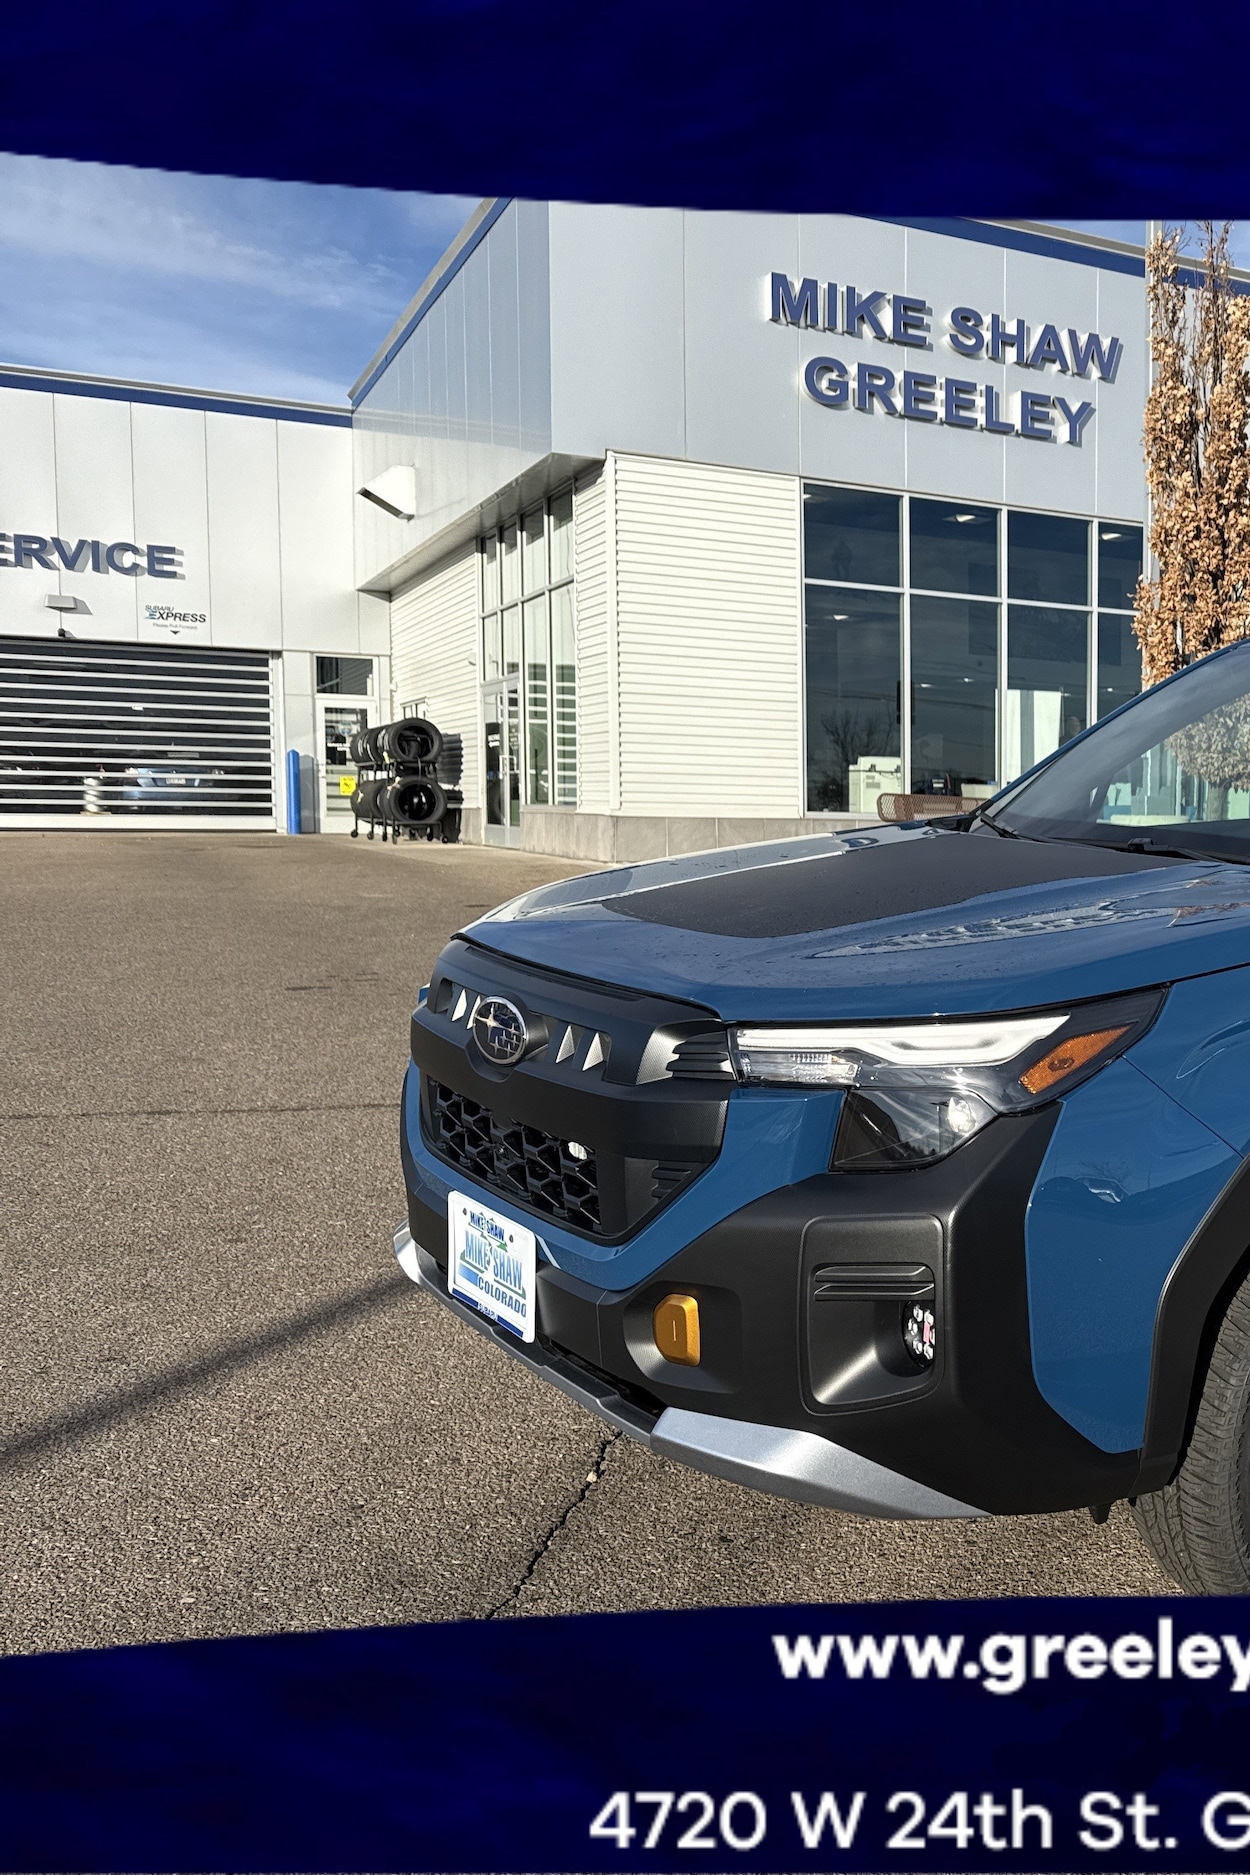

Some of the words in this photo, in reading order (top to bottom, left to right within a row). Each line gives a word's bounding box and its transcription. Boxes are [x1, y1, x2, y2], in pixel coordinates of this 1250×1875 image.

[770, 271, 928, 345] MIKE
[949, 306, 1120, 380] SHAW
[805, 356, 1093, 443] GREELEY
[0, 532, 178, 578] RVICE
[144, 610, 207, 623] EXPRESS
[470, 1210, 485, 1229] MIKE
[486, 1219, 505, 1241] SHAW
[465, 1230, 488, 1269] MIKE
[493, 1247, 523, 1291] SHAW
[478, 1276, 527, 1318] COLORADO
